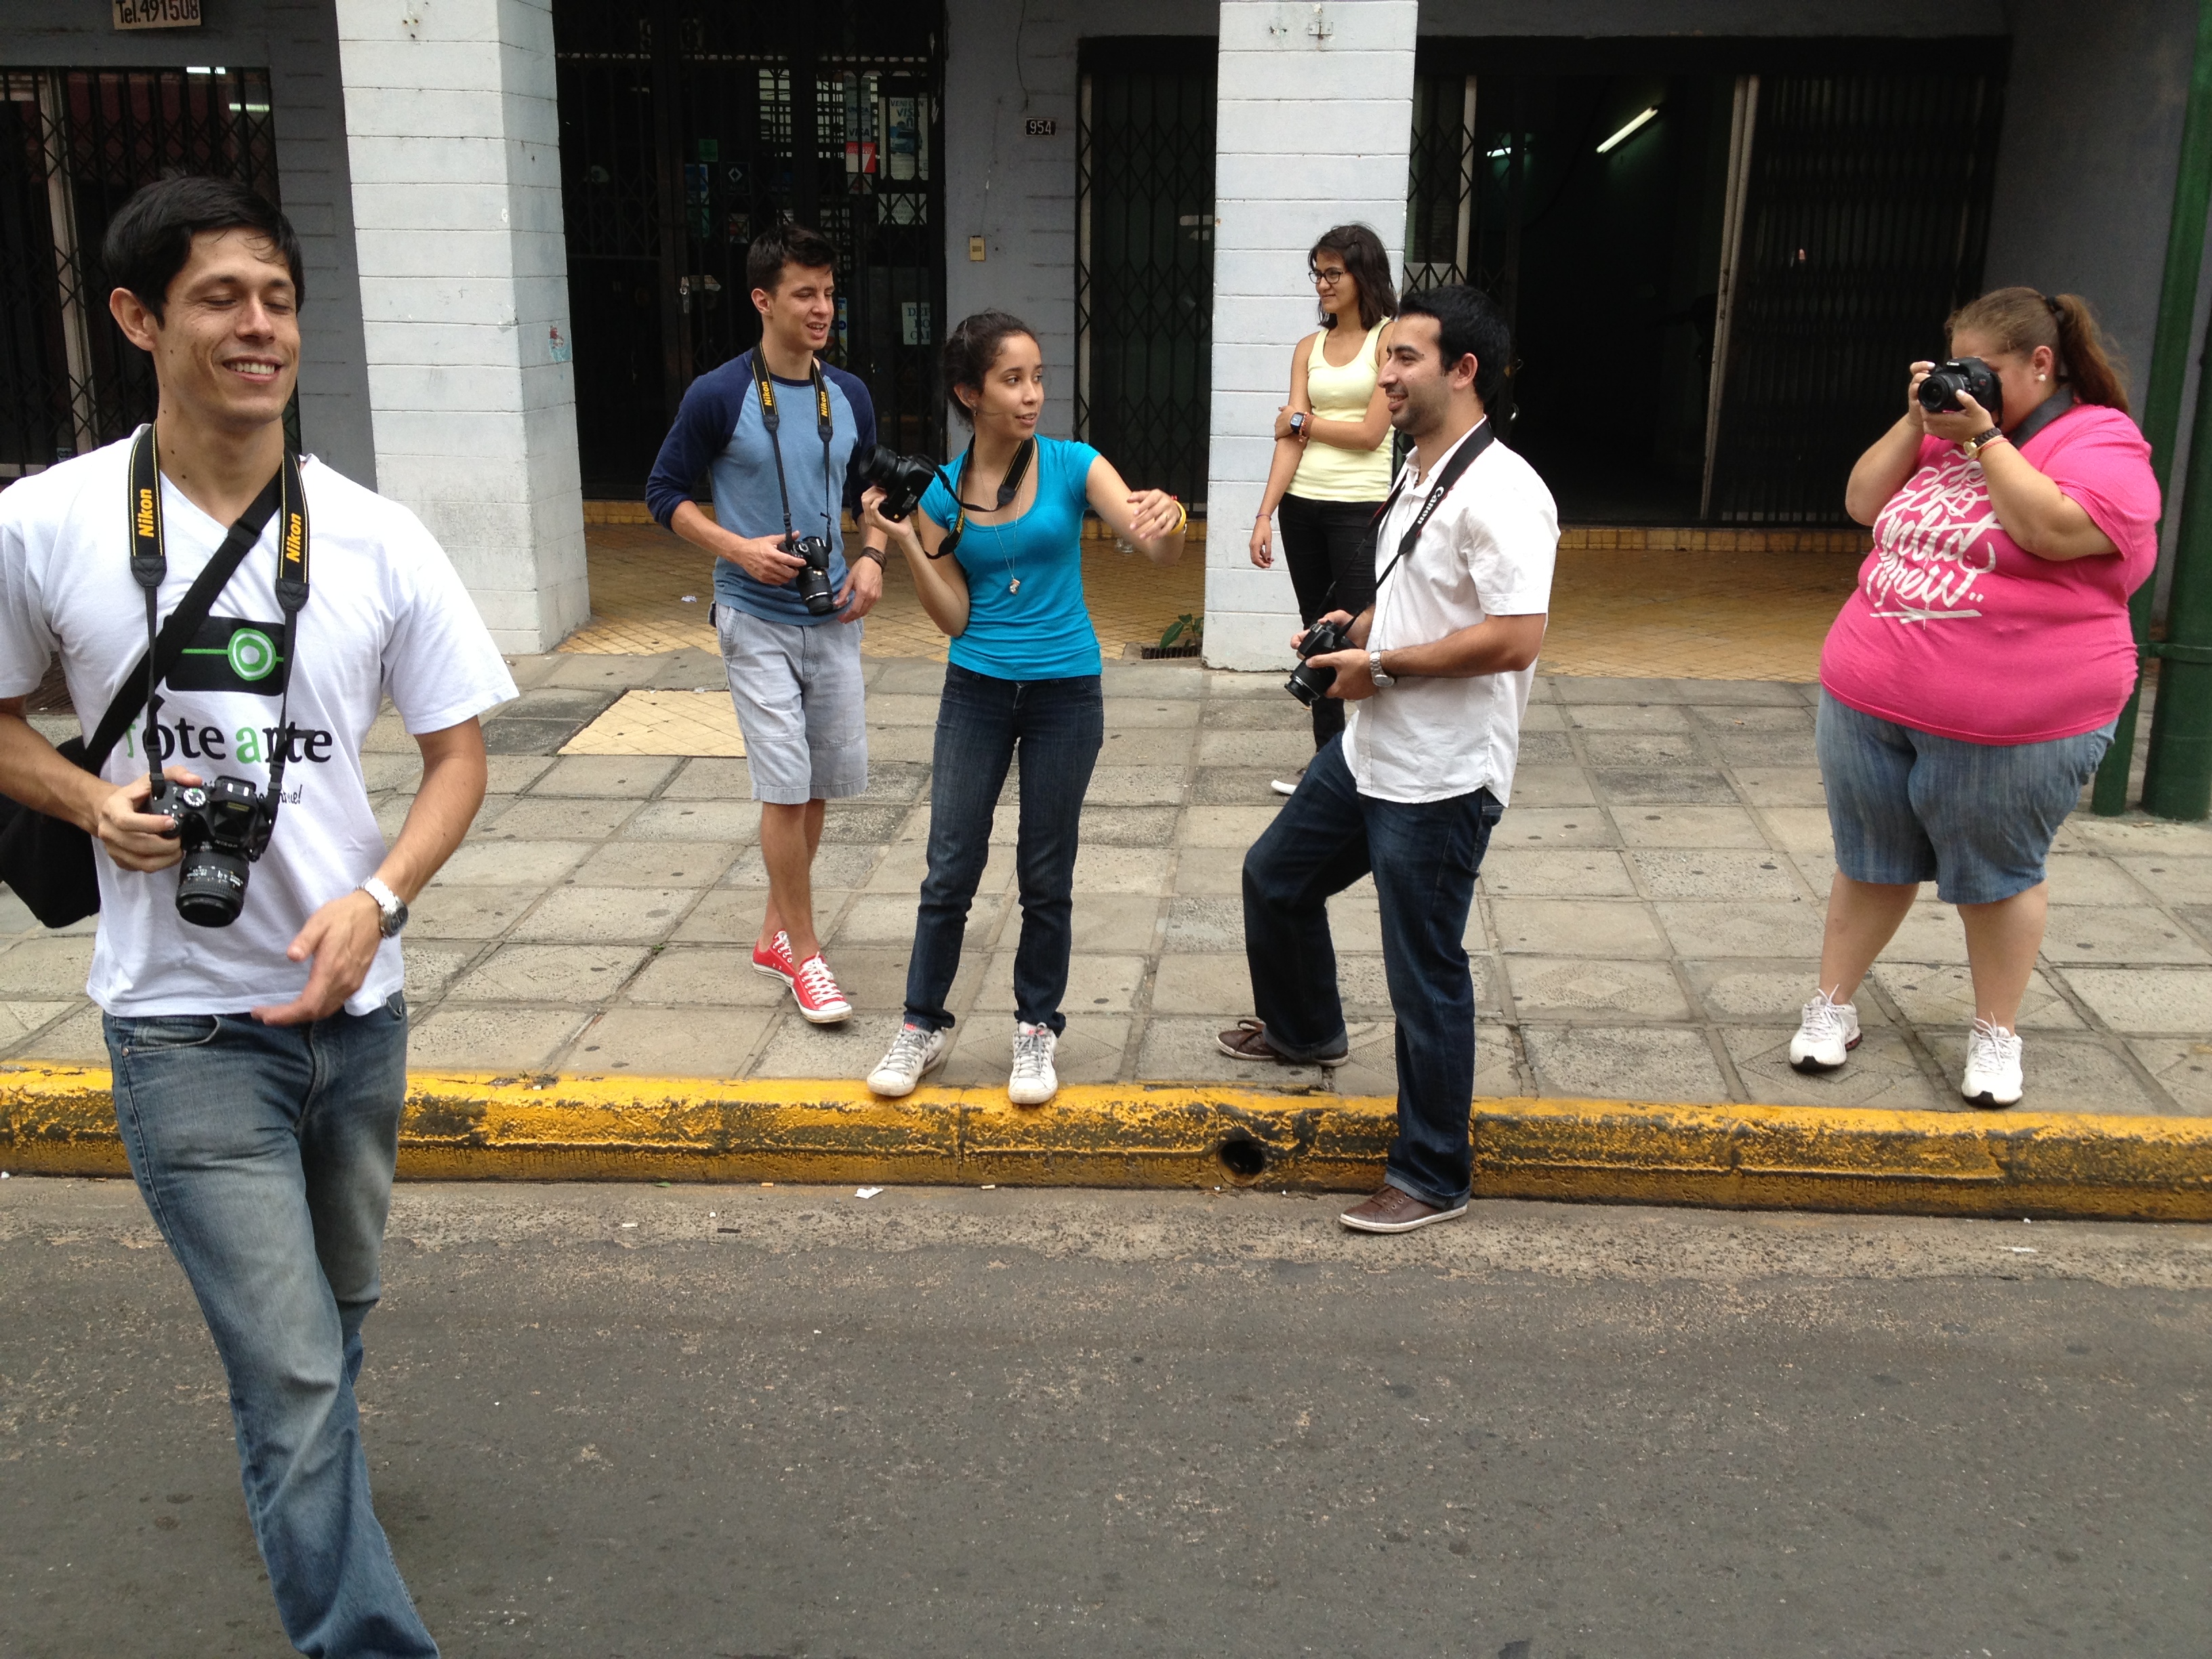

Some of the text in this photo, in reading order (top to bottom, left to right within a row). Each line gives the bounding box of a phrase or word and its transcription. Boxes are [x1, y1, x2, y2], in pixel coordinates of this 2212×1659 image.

[896, 107, 920, 117] VIS
[1030, 121, 1051, 134] 954
[762, 381, 773, 406] Nikon
[820, 391, 828, 417] Nikon
[138, 488, 155, 538] Nikon
[1417, 486, 1444, 525] Canon
[286, 512, 302, 563] Nikon
